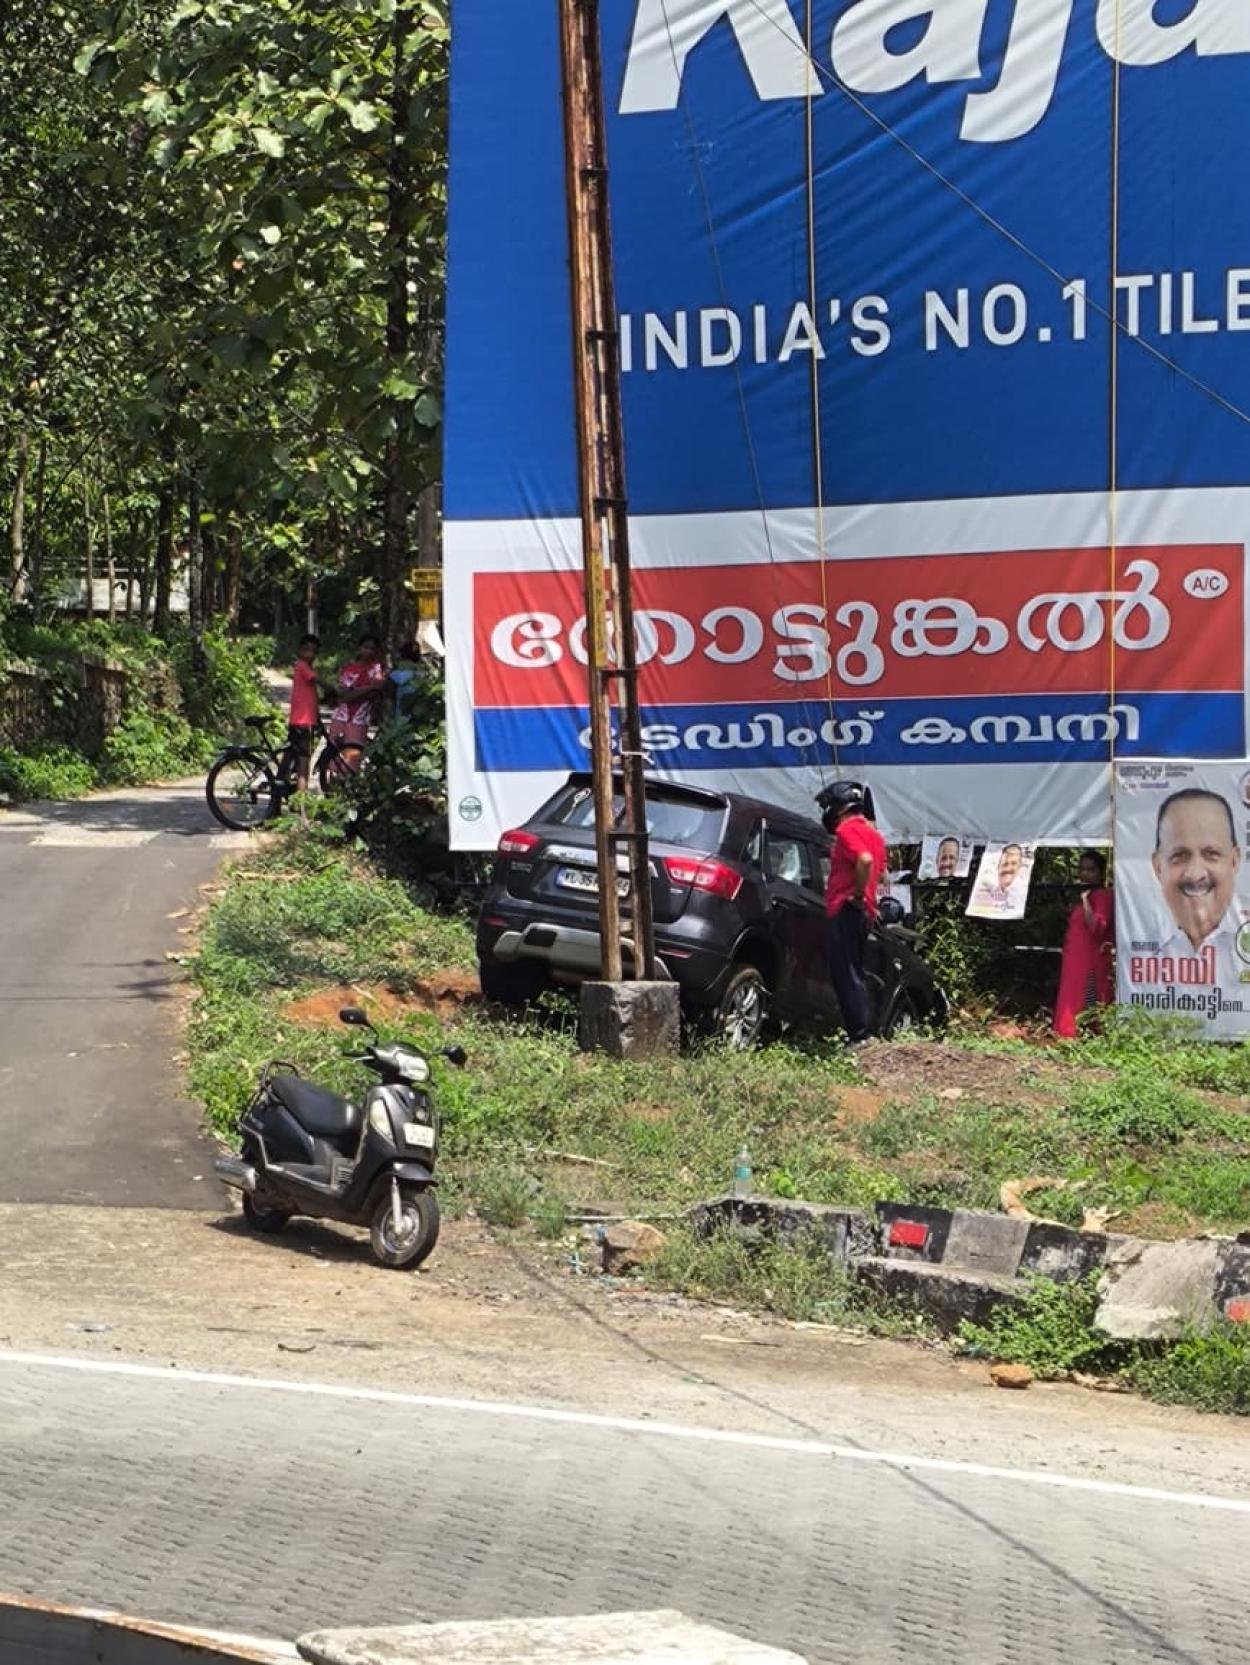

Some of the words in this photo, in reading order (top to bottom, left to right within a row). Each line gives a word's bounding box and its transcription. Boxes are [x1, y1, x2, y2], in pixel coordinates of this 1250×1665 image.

[622, 295, 891, 372] INDIA'S
[924, 279, 1088, 351] NO.1
[1115, 268, 1250, 337] TILE
[1192, 574, 1221, 592] A/C
[900, 704, 1140, 745] കമ്പനി
